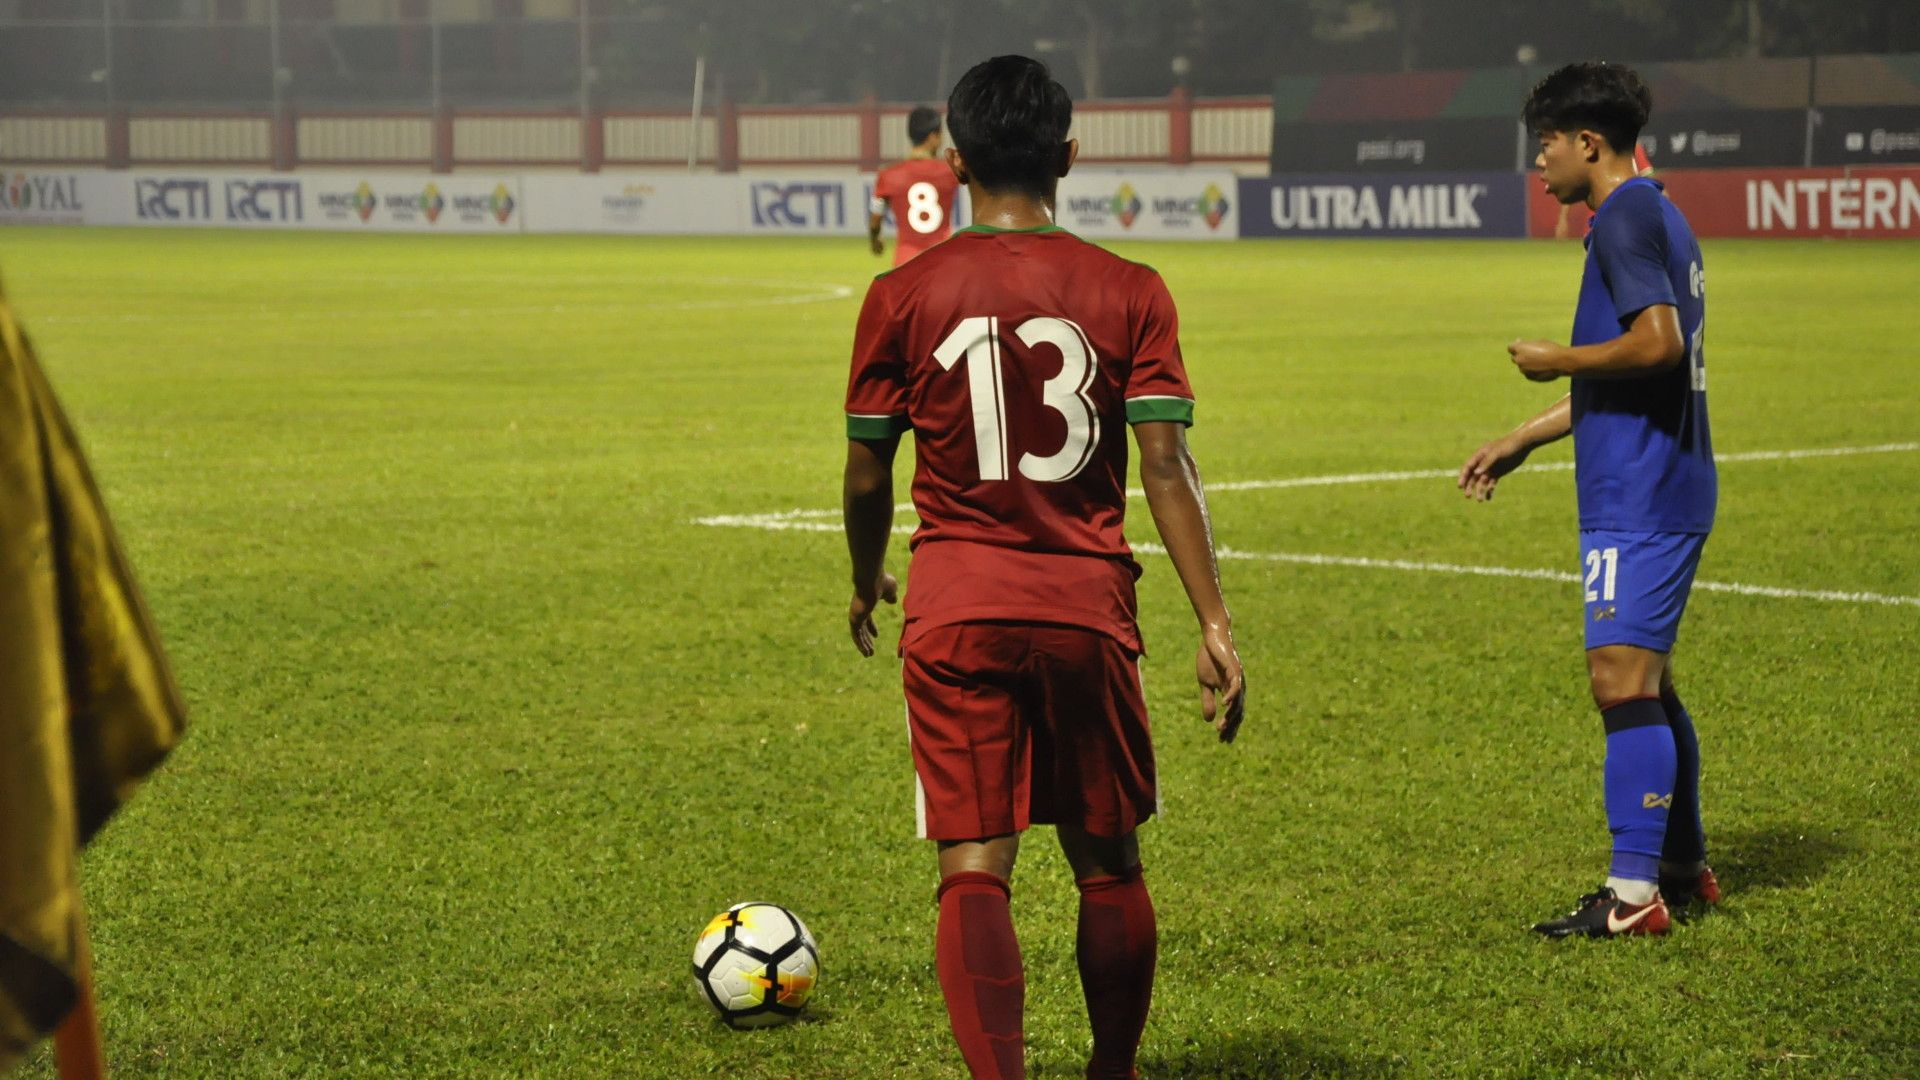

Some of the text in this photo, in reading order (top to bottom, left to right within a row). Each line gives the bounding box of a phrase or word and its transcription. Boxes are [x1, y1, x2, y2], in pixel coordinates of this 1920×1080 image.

[135, 180, 304, 220] RCTI RCTI
[751, 181, 844, 227] RCTI
[907, 181, 944, 234] 8
[1067, 196, 1113, 214] MNC
[1152, 196, 1200, 215] MNC
[1271, 184, 1481, 229] ULTRA MILK
[1746, 178, 1920, 231] INTERN
[933, 316, 1101, 483] 13
[1584, 547, 1619, 603] 21
